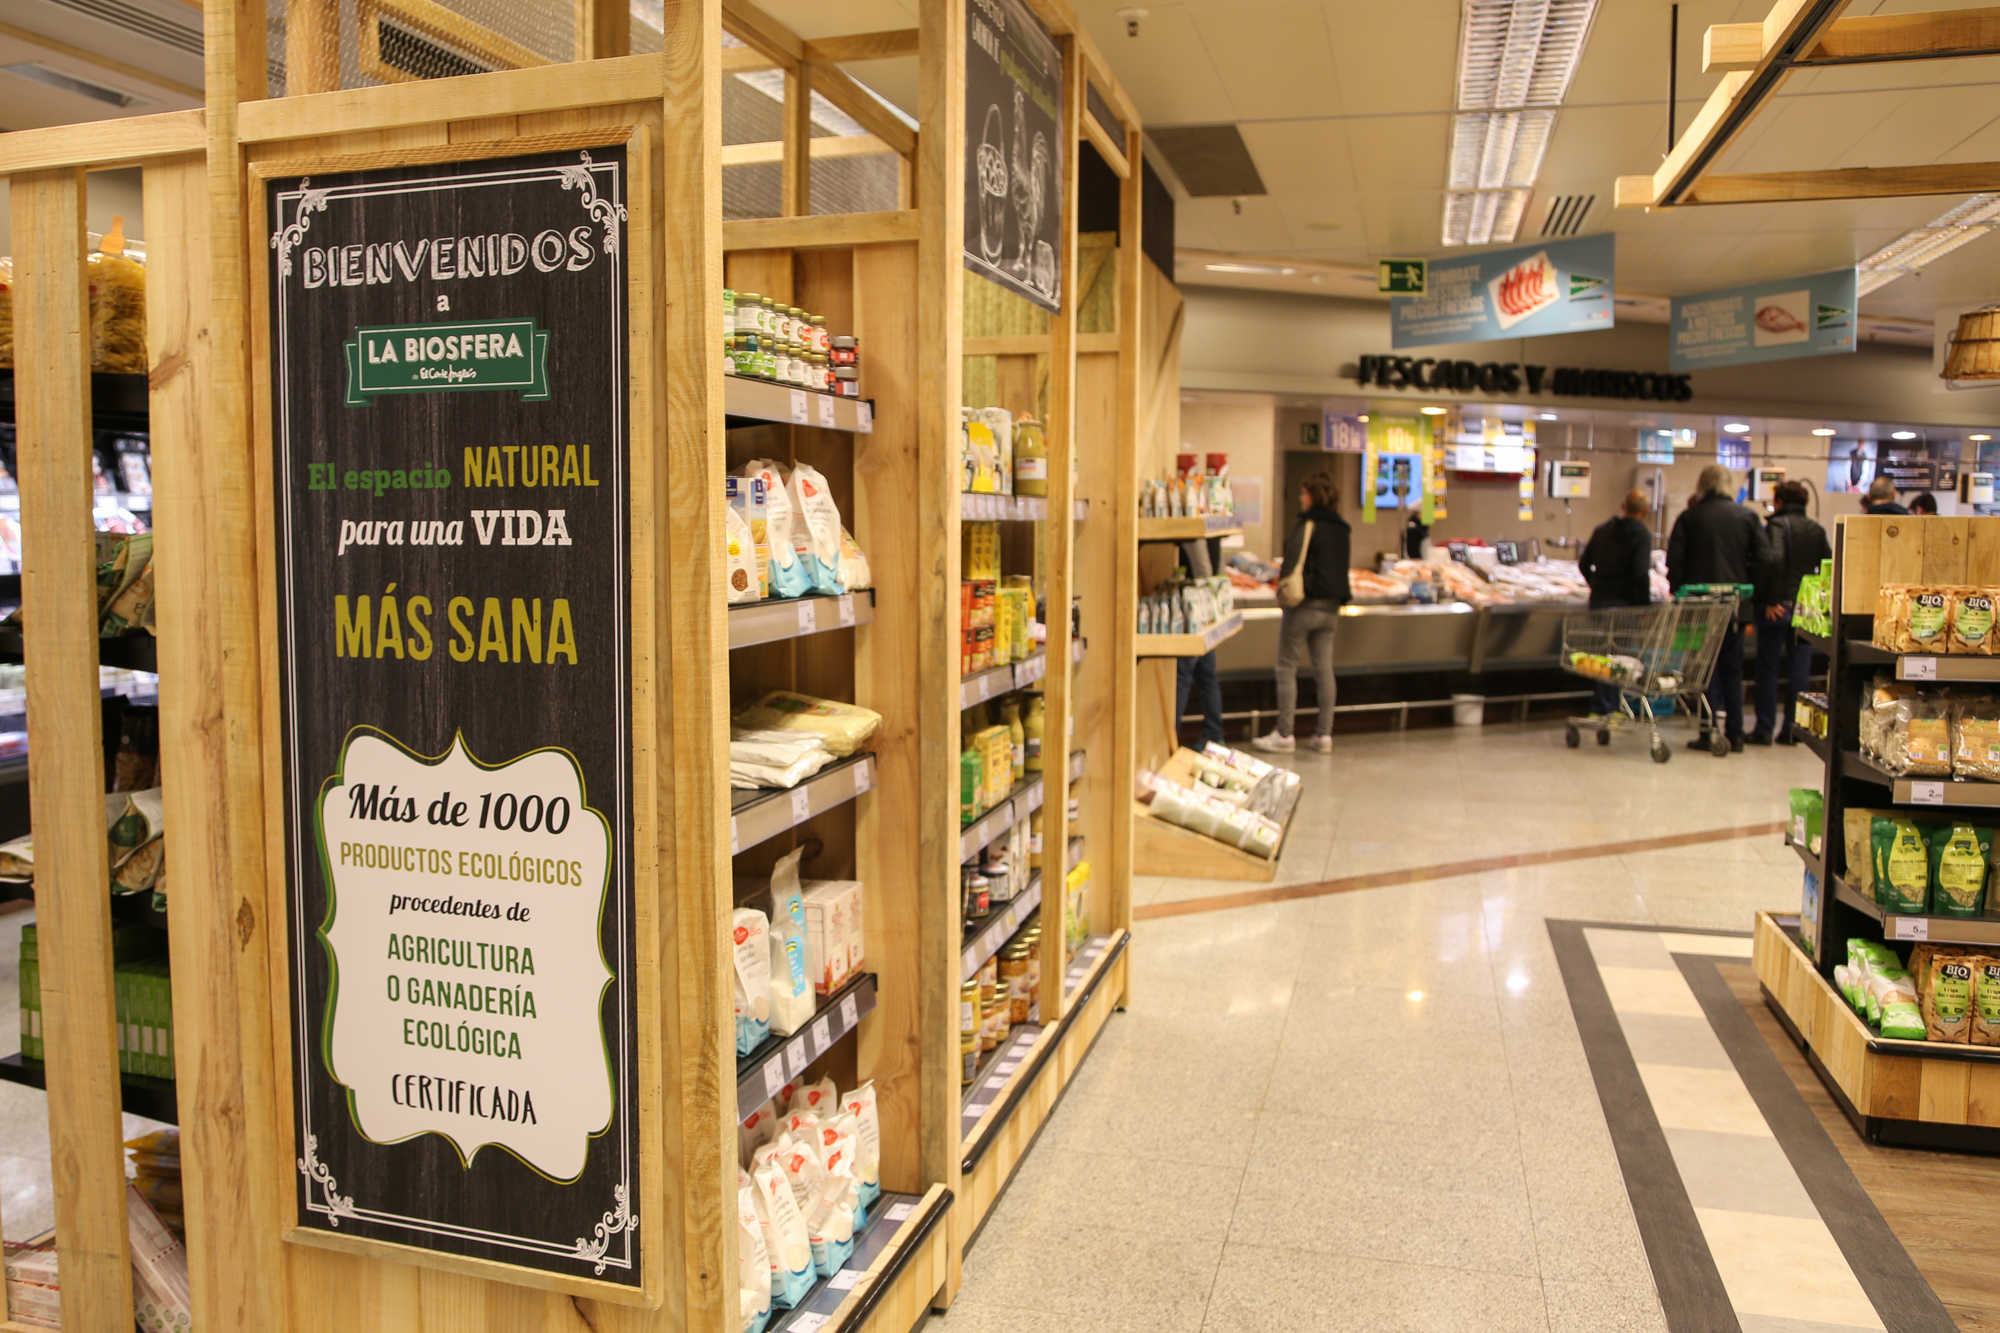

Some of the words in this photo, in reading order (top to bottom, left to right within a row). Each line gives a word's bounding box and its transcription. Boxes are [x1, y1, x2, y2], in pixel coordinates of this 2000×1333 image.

[303, 226, 595, 288] BIENVENIDOS
[436, 293, 450, 312] a
[368, 337, 399, 364] LA
[404, 333, 524, 362] BIOSFERA
[1359, 355, 1521, 394] PESCADOS
[1525, 365, 1546, 394] Y
[308, 463, 337, 490] El
[344, 462, 451, 496] espacio
[464, 445, 599, 488] NATURAL
[338, 519, 403, 556] para
[410, 520, 464, 546] una
[471, 509, 572, 546] VIDA
[334, 582, 433, 661] MÁS
[447, 595, 578, 665] SANA
[349, 783, 421, 823] Más
[427, 791, 470, 826] de
[479, 792, 570, 834] 1000
[340, 842, 452, 875] PRODUCTOS
[459, 850, 582, 887] ECOLÓGICOS
[389, 893, 501, 919] procedentes
[506, 902, 531, 922] de
[387, 933, 535, 975] AGRICULTURA
[1946, 964, 1967, 977] BIO
[387, 975, 401, 1001] O
[407, 977, 537, 1019] GANADERÍA
[403, 1018, 522, 1060] ECOLÓGICA
[391, 1073, 537, 1125] CERTIFICADA
